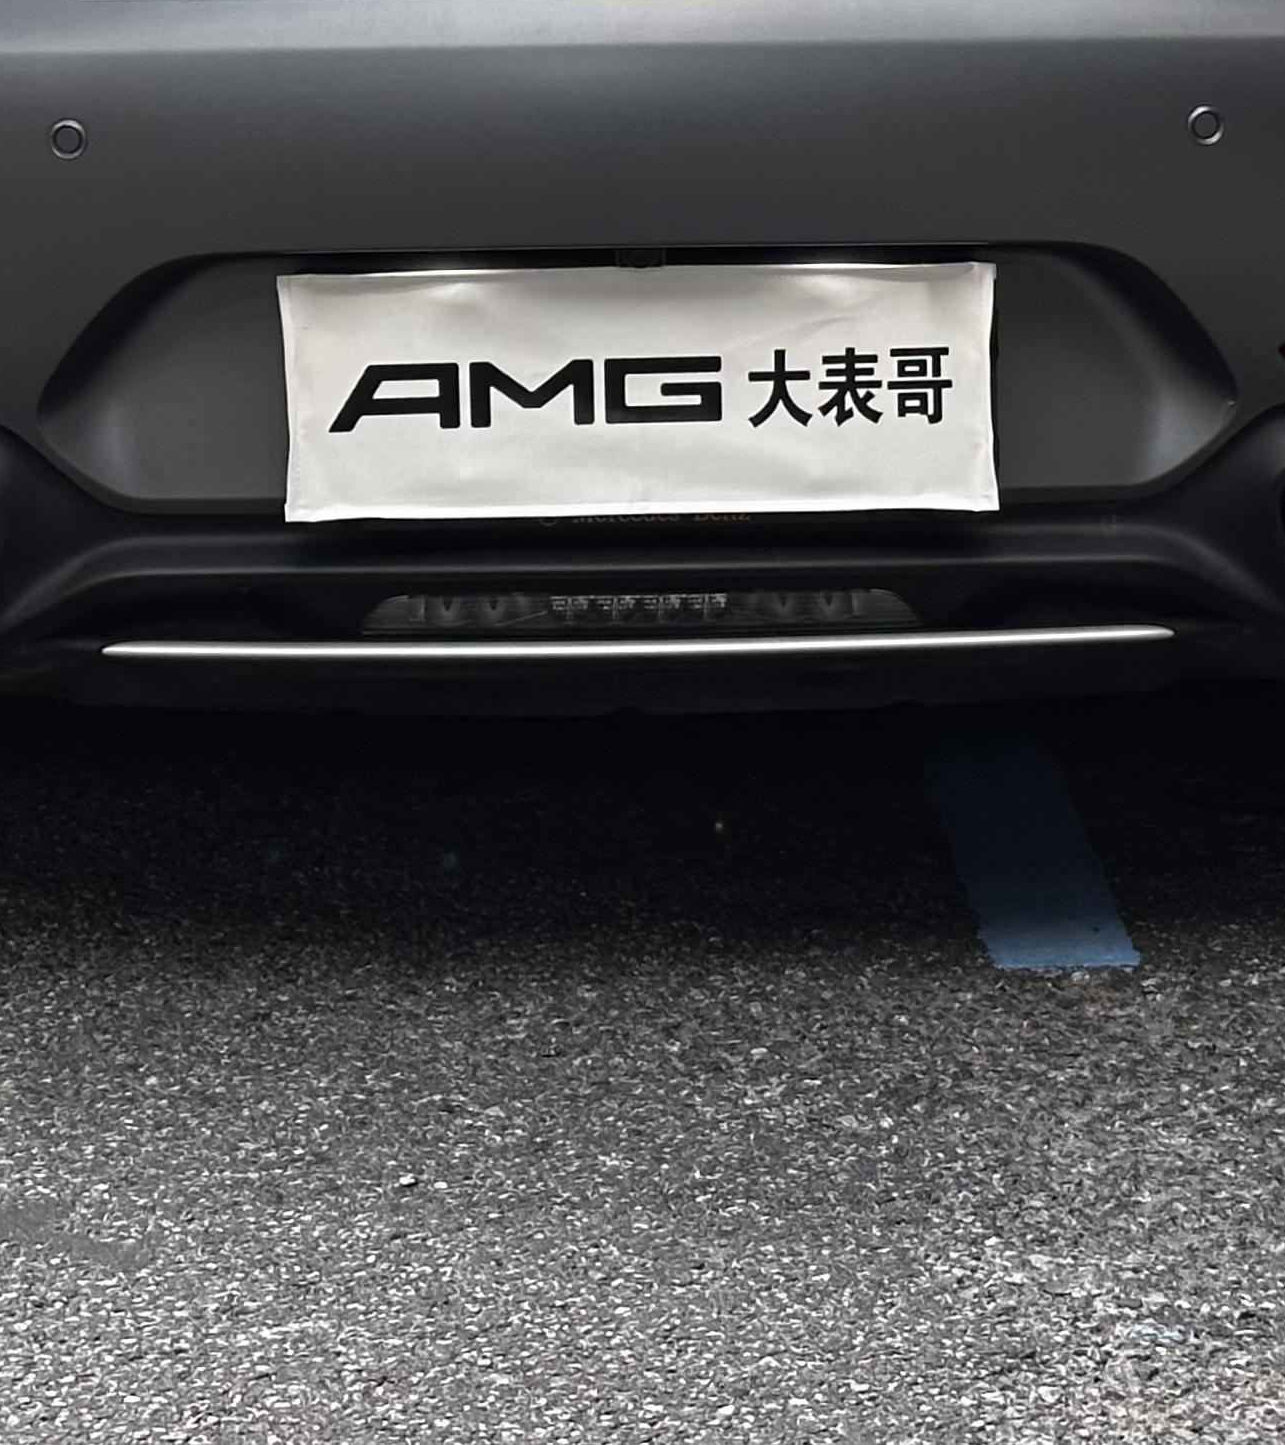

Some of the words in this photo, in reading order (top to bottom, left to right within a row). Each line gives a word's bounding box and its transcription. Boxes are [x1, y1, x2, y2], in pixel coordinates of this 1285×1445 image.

[329, 356, 722, 433] AMG
[748, 347, 953, 428] 大表哥
